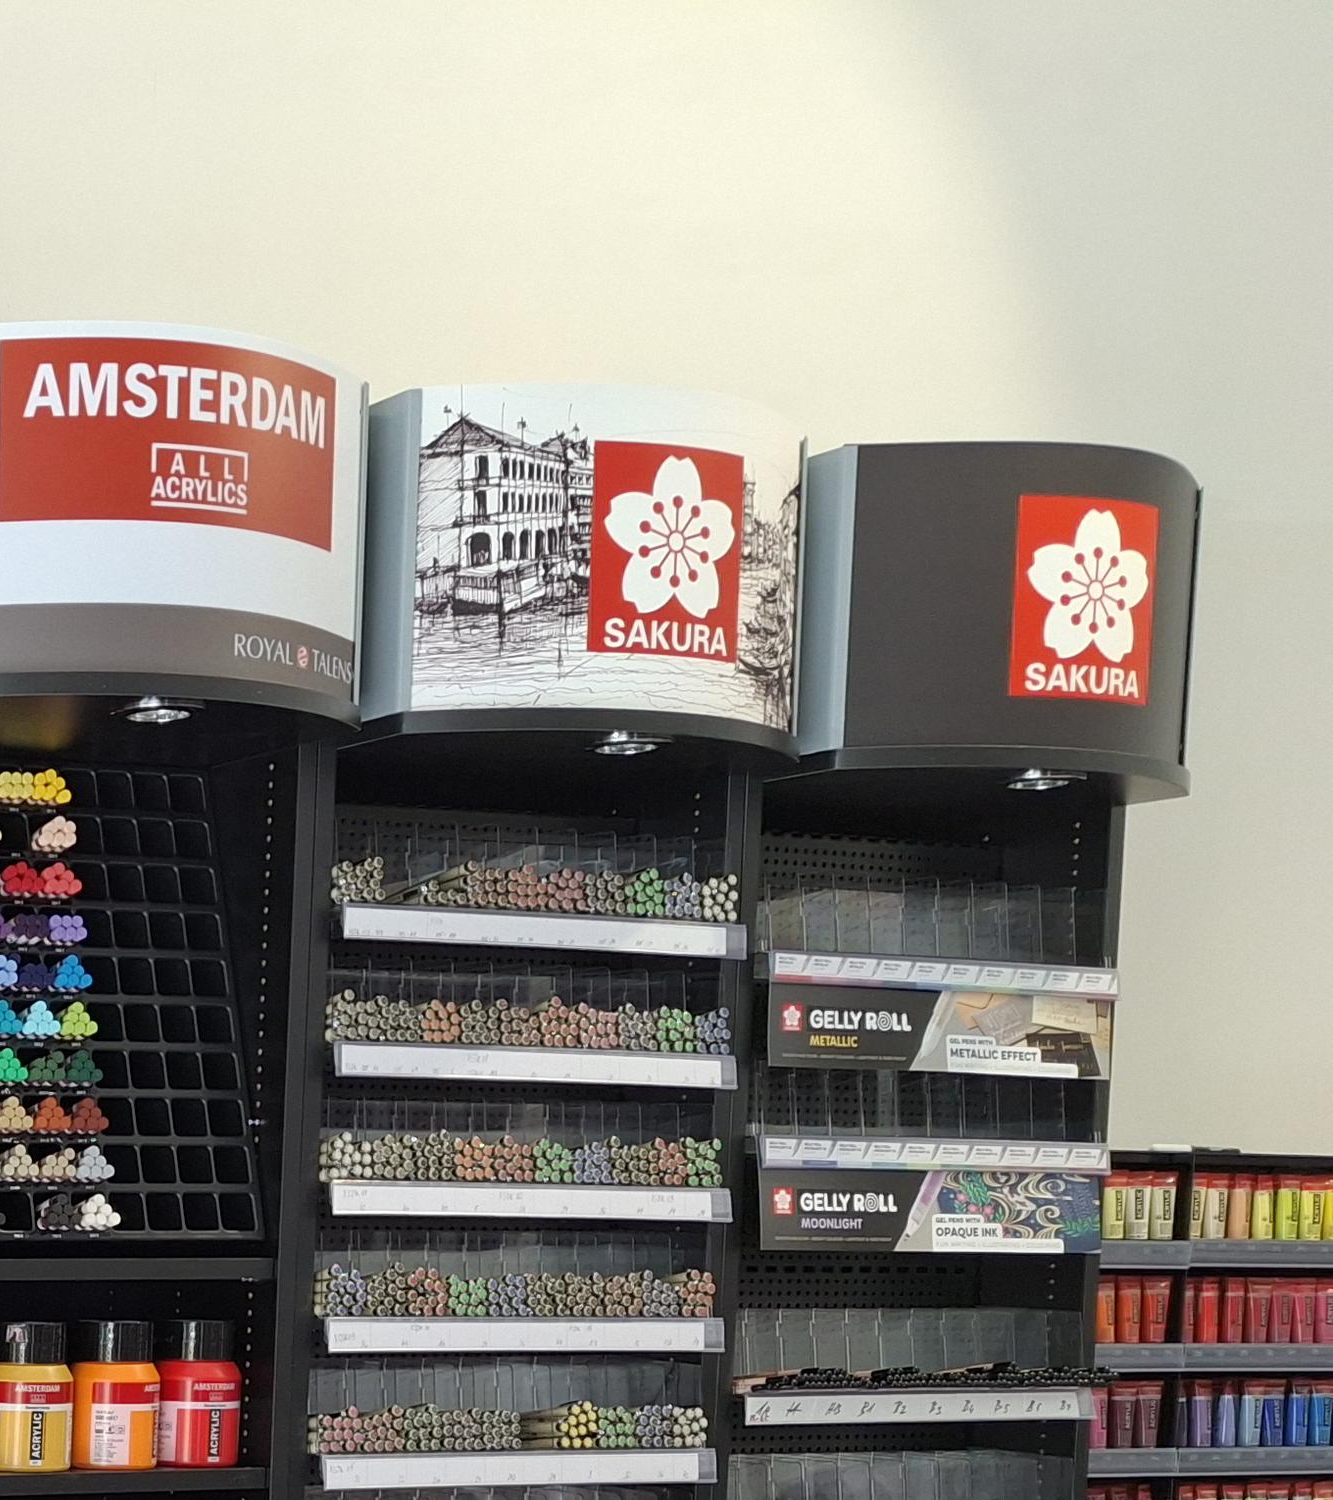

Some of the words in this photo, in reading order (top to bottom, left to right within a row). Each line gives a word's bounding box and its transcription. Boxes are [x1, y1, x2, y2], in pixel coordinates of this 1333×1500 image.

[23, 360, 326, 451] AMSTERDAM
[170, 452, 239, 480] ALL
[150, 475, 249, 507] ACRYLICS
[603, 617, 728, 659] SAKURA
[233, 632, 292, 666] ROYAL
[311, 649, 353, 685] TALENS
[1024, 662, 1141, 699] SAKURA
[809, 1009, 862, 1031] GELLY
[866, 1011, 912, 1031] ROLL
[810, 1035, 858, 1047] METALLIC
[949, 1037, 962, 1045] GEL
[978, 1038, 993, 1046] WITH
[950, 1047, 998, 1061] METALLIC
[1001, 1050, 1037, 1062] EFFECT
[800, 1192, 851, 1212] GELLY
[854, 1193, 898, 1213] ROLL
[801, 1217, 863, 1230] MOONLIGHT
[935, 1216, 949, 1224] GEL
[936, 1226, 978, 1239] OPAQUE
[981, 1227, 999, 1238] INK
[15, 1384, 60, 1393] AMSTERDAM
[31, 1412, 42, 1459] ACRYLIC
